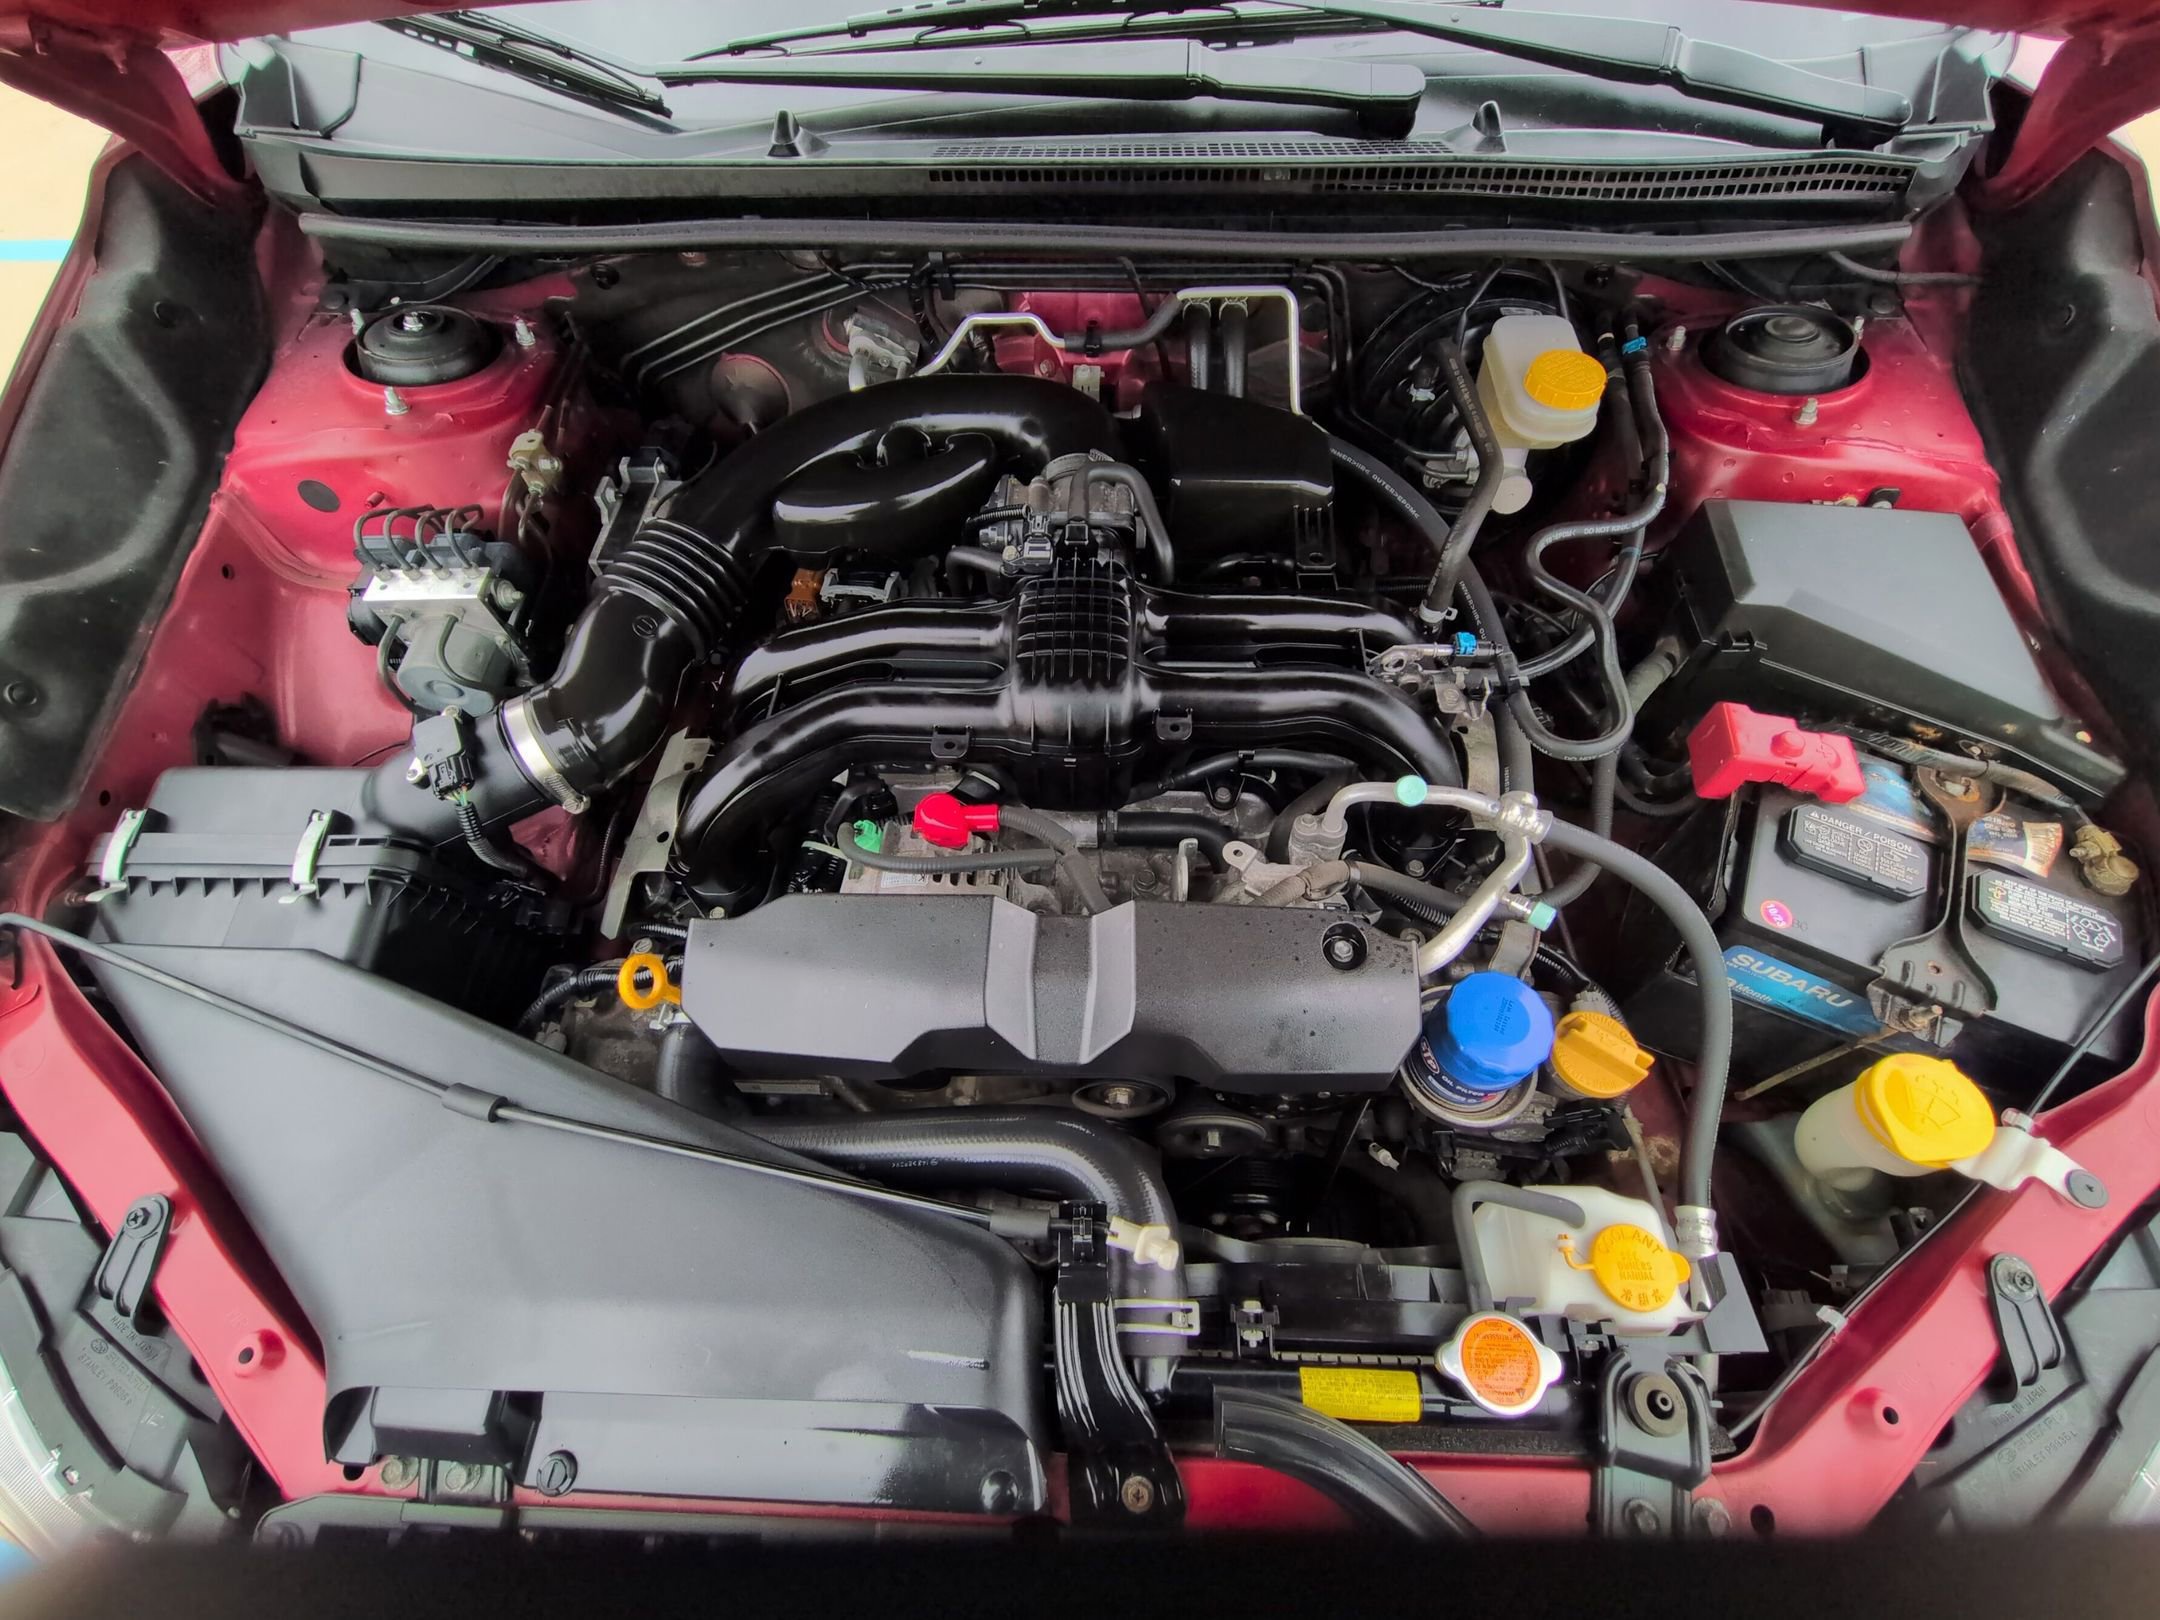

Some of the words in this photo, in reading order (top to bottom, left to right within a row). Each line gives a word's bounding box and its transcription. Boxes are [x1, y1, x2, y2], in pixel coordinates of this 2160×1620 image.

[1820, 814, 1863, 835] DANGER
[1873, 833, 1912, 852] POISON
[1732, 953, 1853, 1008] SUBARU
